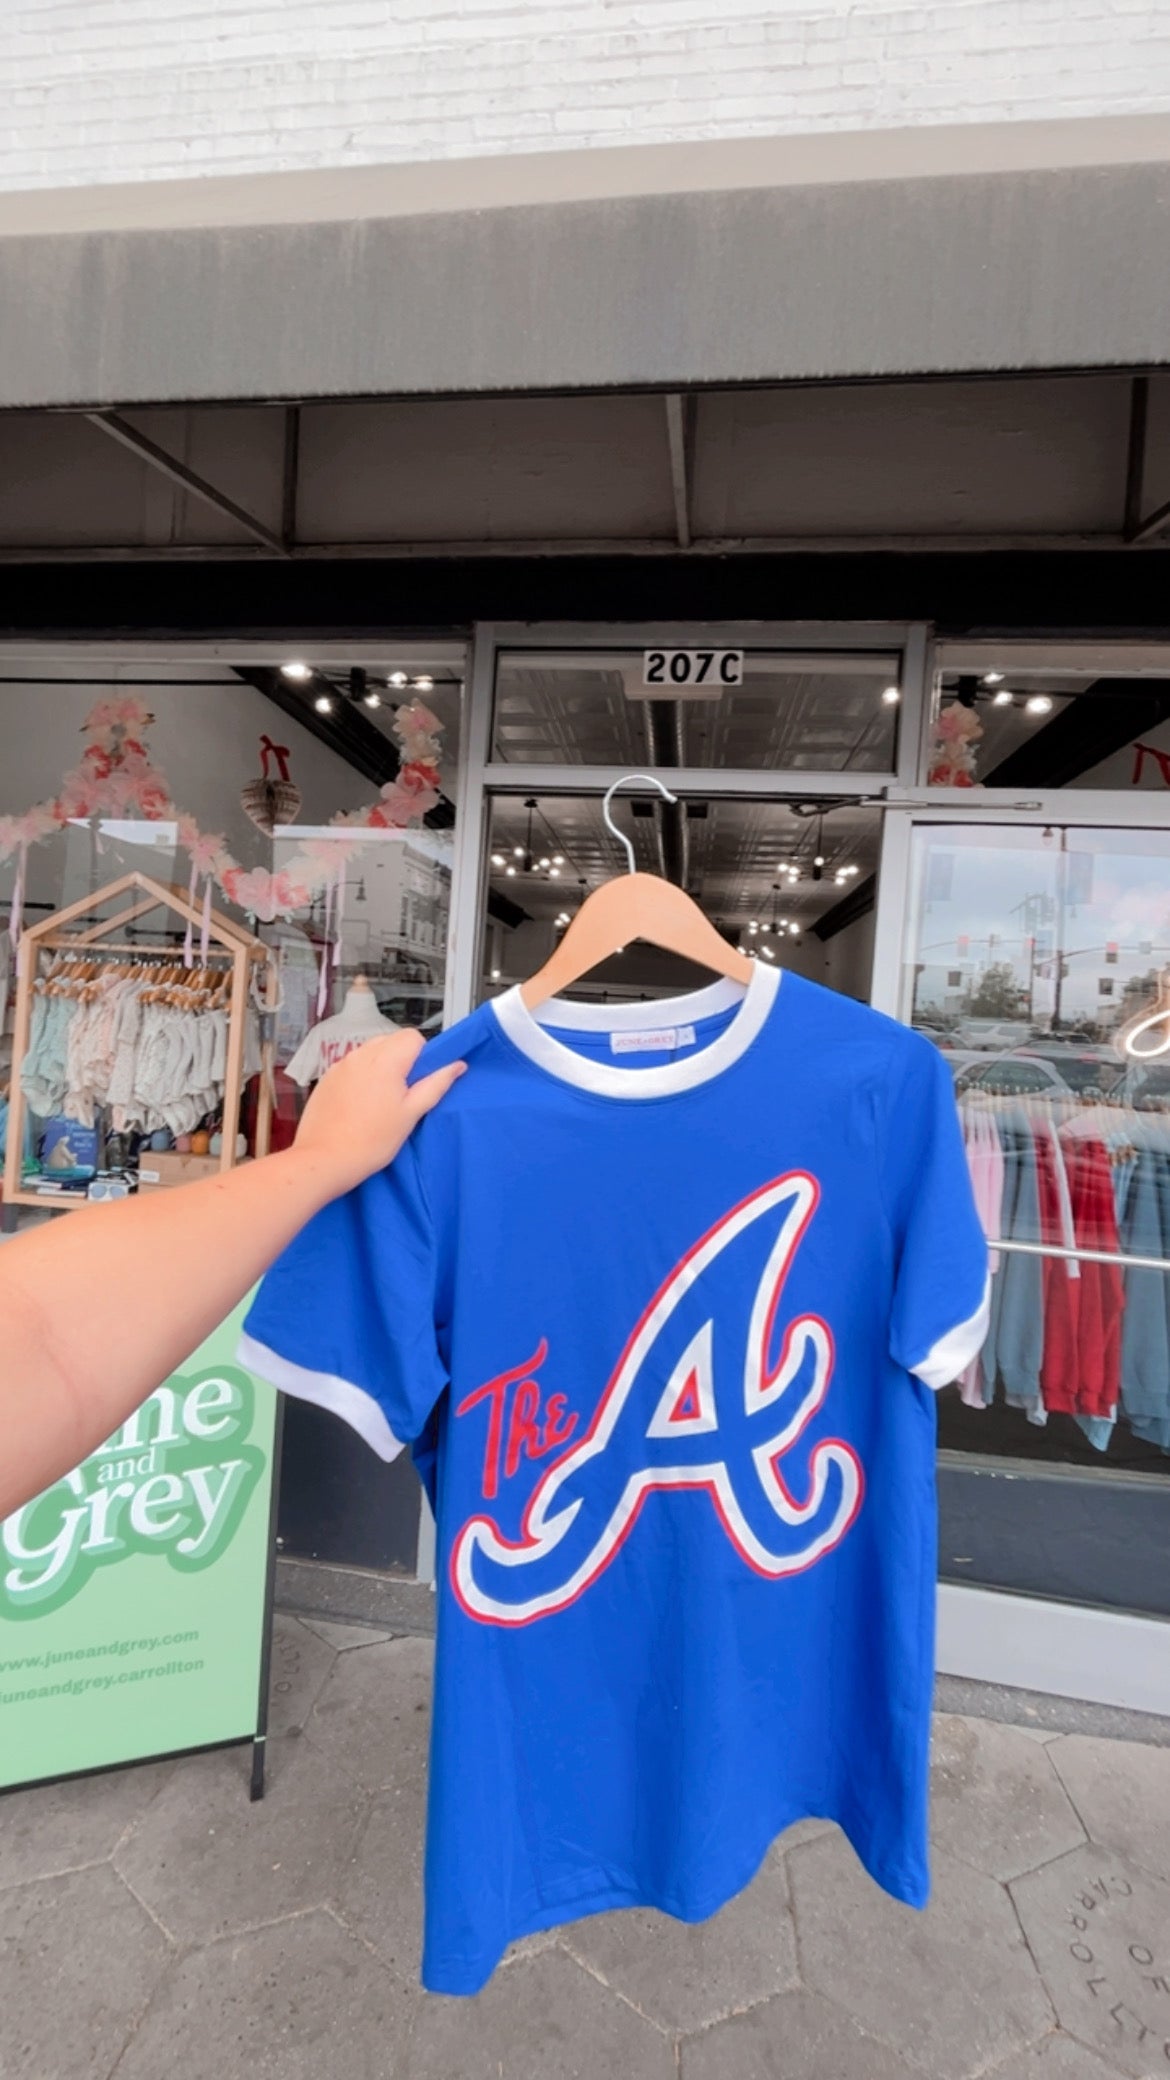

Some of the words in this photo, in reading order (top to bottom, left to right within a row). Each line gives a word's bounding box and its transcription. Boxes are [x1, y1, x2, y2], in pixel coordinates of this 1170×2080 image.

[647, 652, 740, 683] 207C
[449, 1167, 866, 1629] A
[97, 1448, 155, 1484] and
[2, 1458, 244, 1592] Grey
